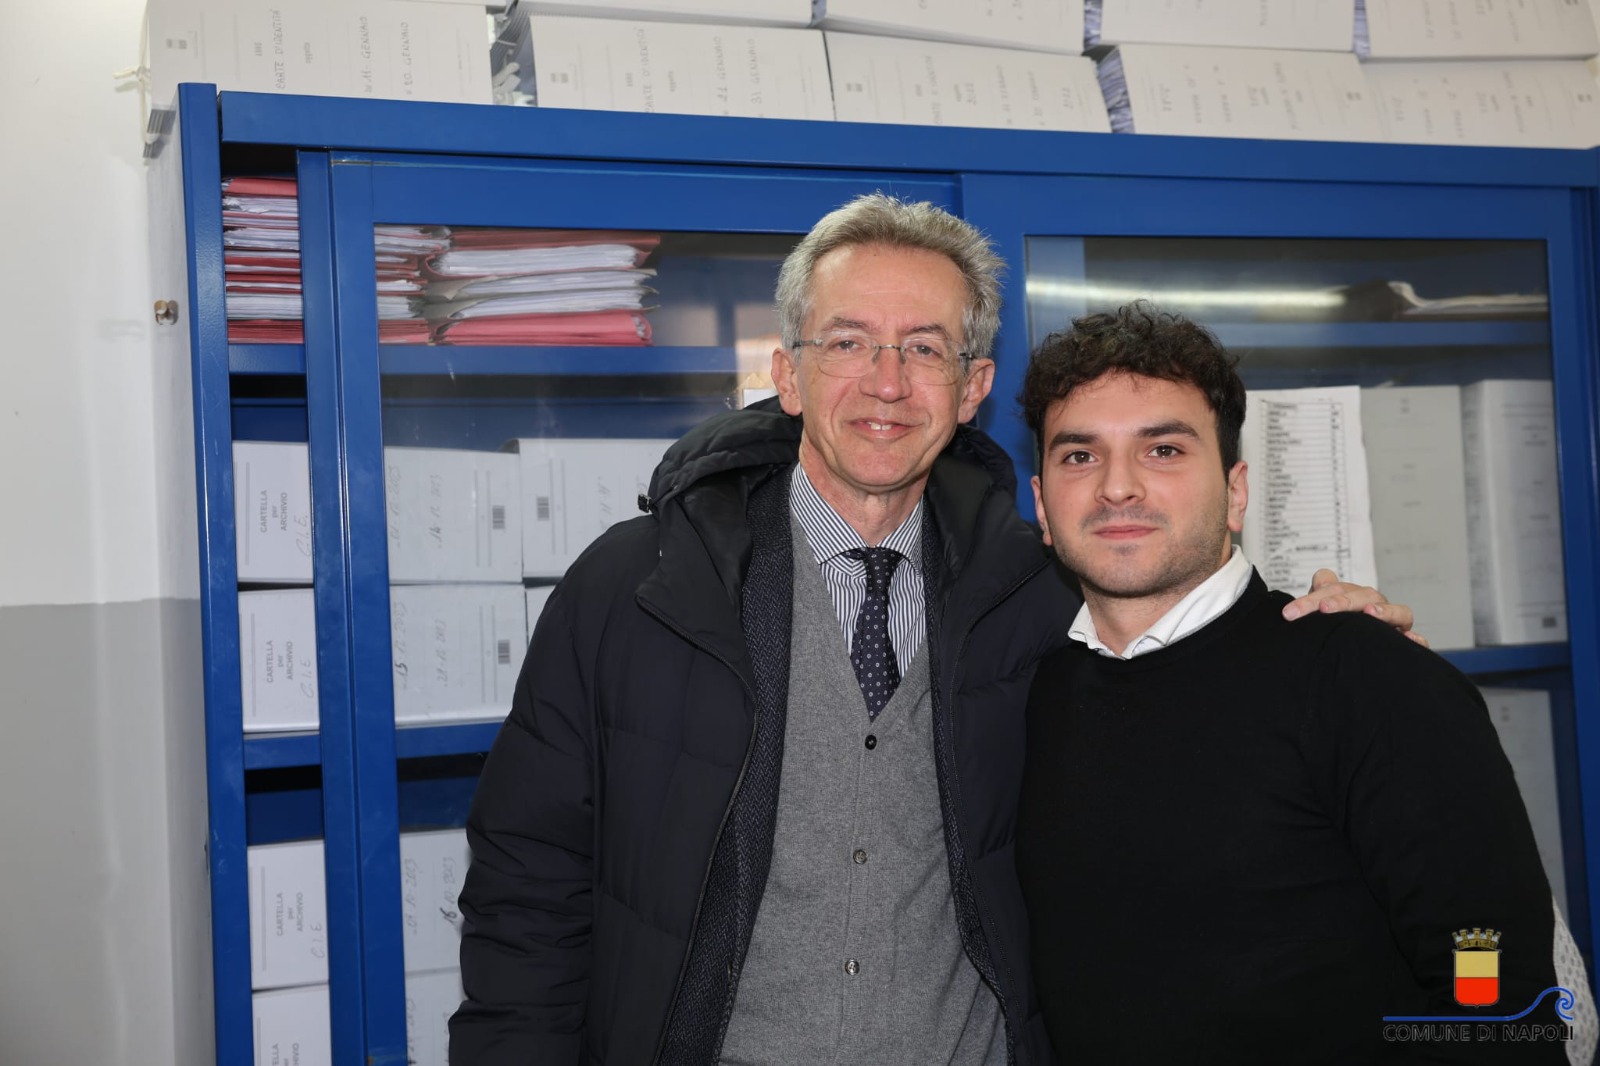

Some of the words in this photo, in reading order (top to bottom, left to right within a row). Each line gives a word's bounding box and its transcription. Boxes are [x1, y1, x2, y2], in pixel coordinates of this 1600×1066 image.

[260, 490, 268, 533] CARTELLA
[280, 492, 288, 531] ARCHIVIO
[266, 640, 274, 683] CARTELLA
[286, 641, 294, 680] ARCHIVIO
[276, 892, 284, 936] CARTELLA
[296, 892, 304, 932] ARCHIVIO
